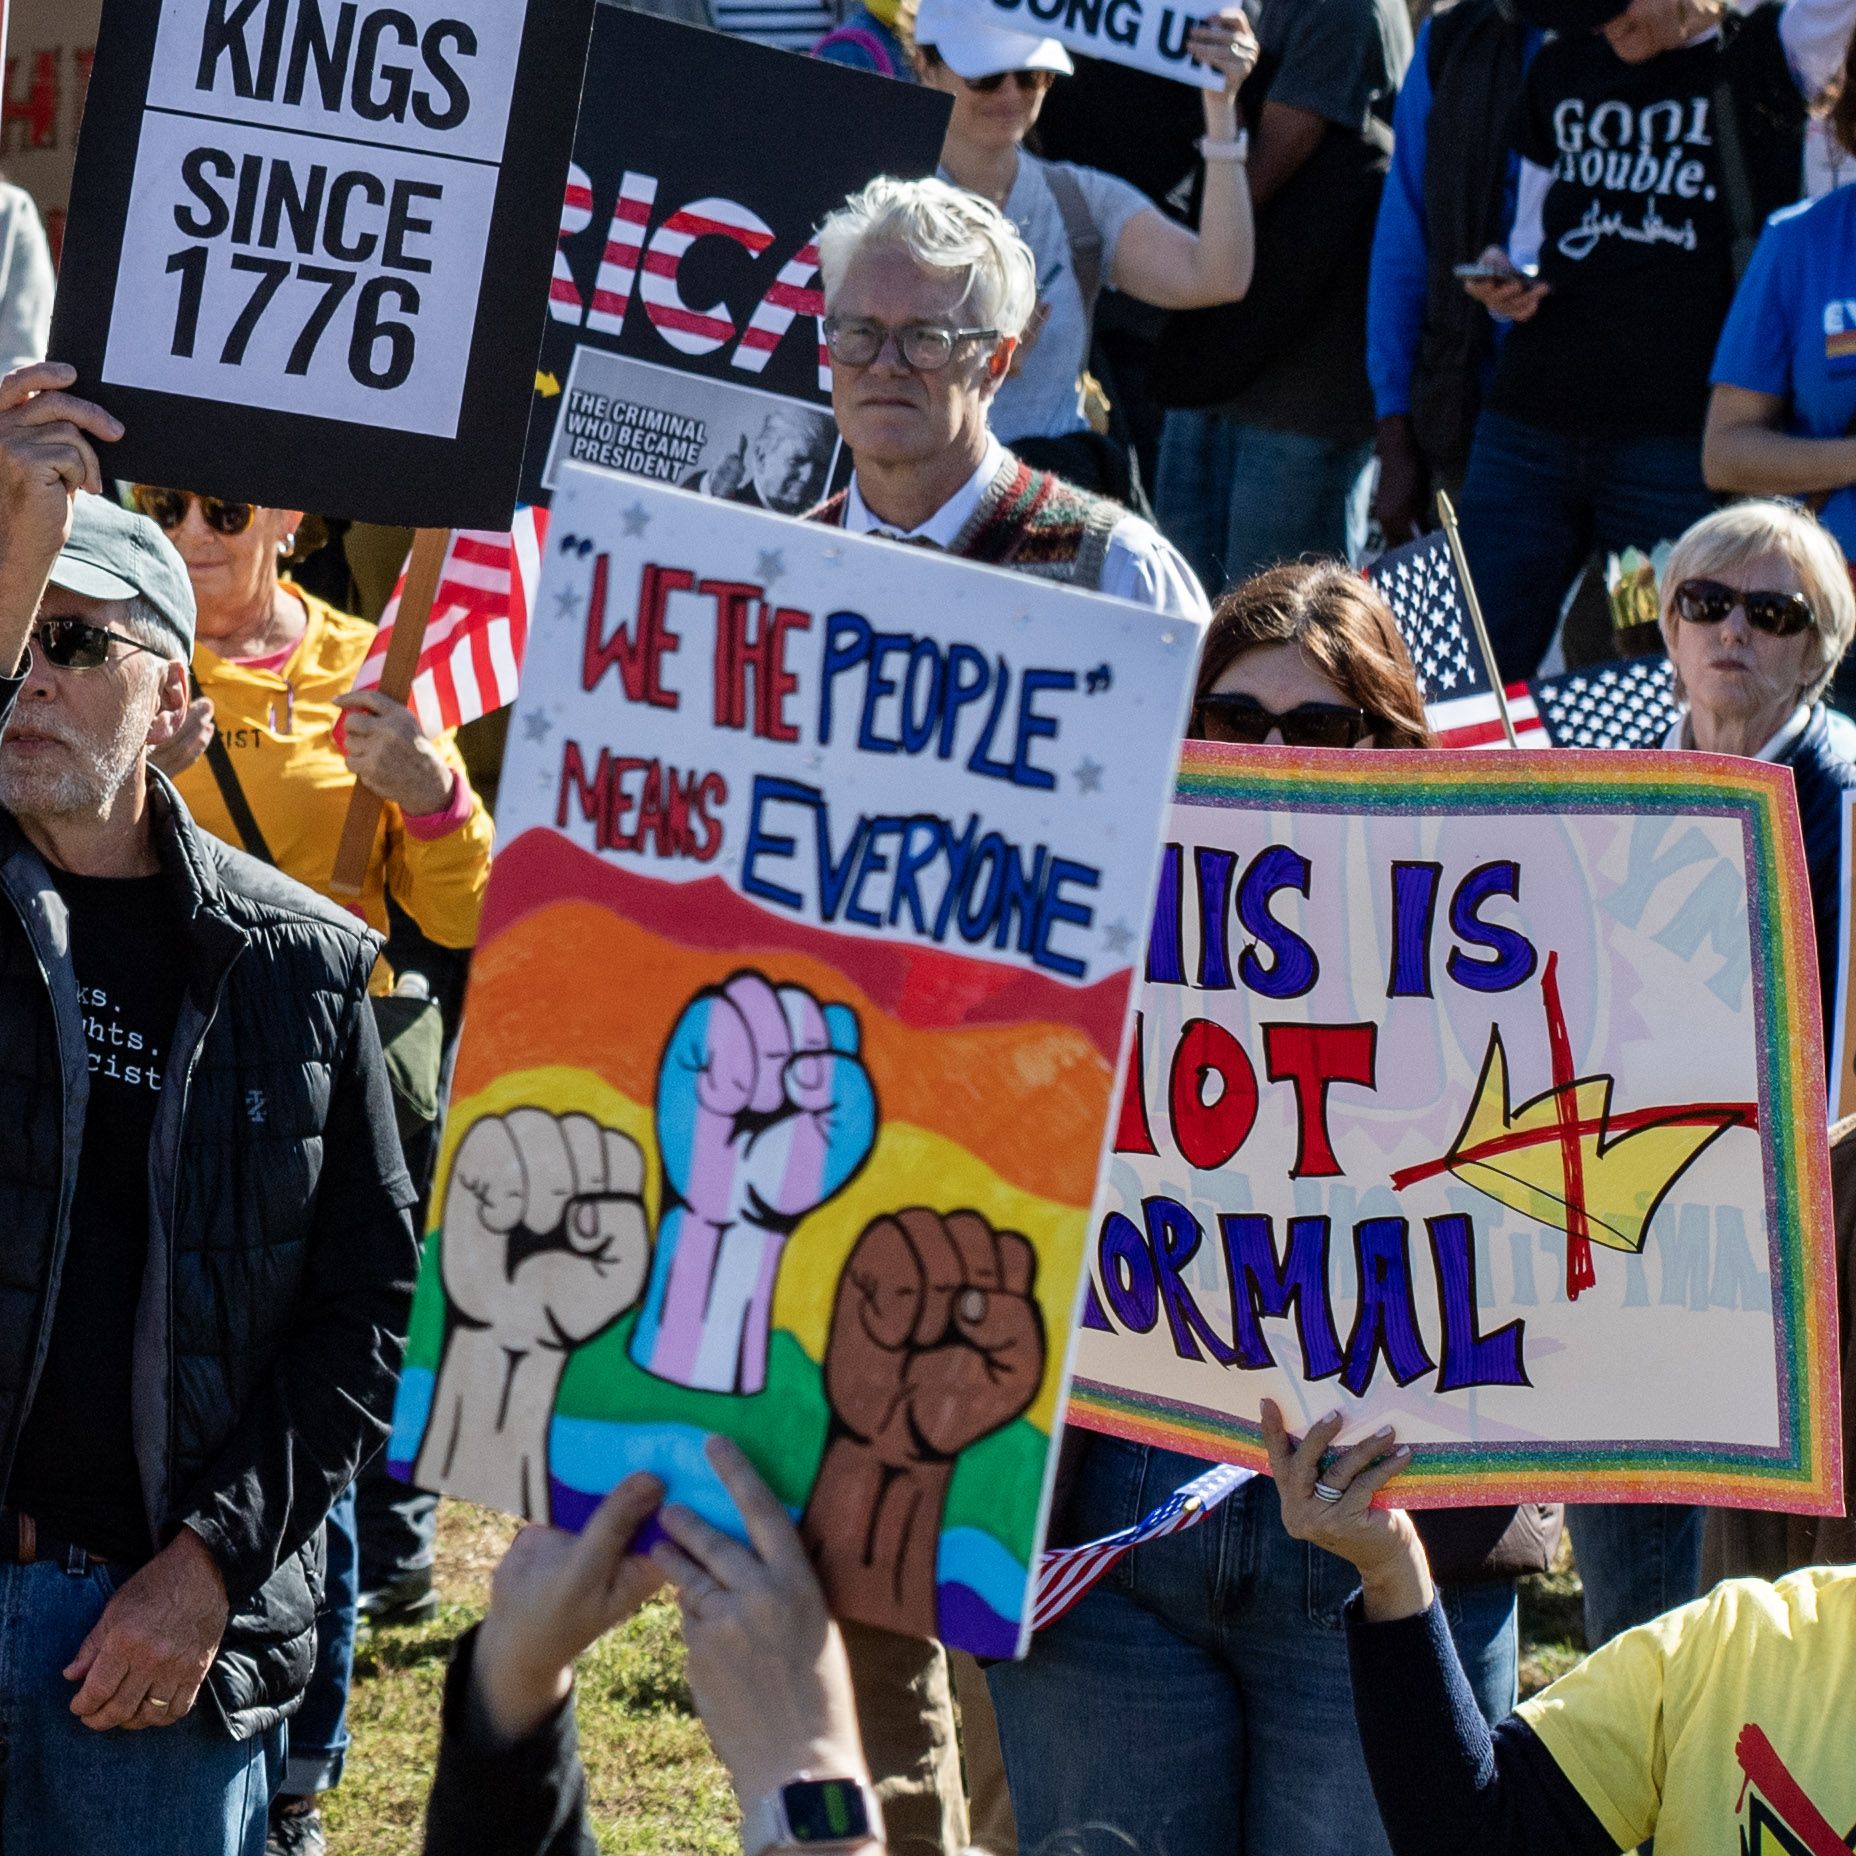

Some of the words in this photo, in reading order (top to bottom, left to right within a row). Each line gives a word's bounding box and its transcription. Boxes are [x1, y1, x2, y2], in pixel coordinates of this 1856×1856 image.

[172, 146, 444, 274] SINCE
[164, 245, 422, 391] 1776
[567, 413, 614, 441] WHO
[617, 430, 701, 464] BECAME
[569, 391, 609, 418] THE
[612, 402, 706, 444] CRIMINAL
[573, 437, 684, 481] PRESIDENT
[700, 579, 812, 744] THE
[741, 774, 1102, 979] EVERYONE
[1385, 859, 1539, 998] IS
